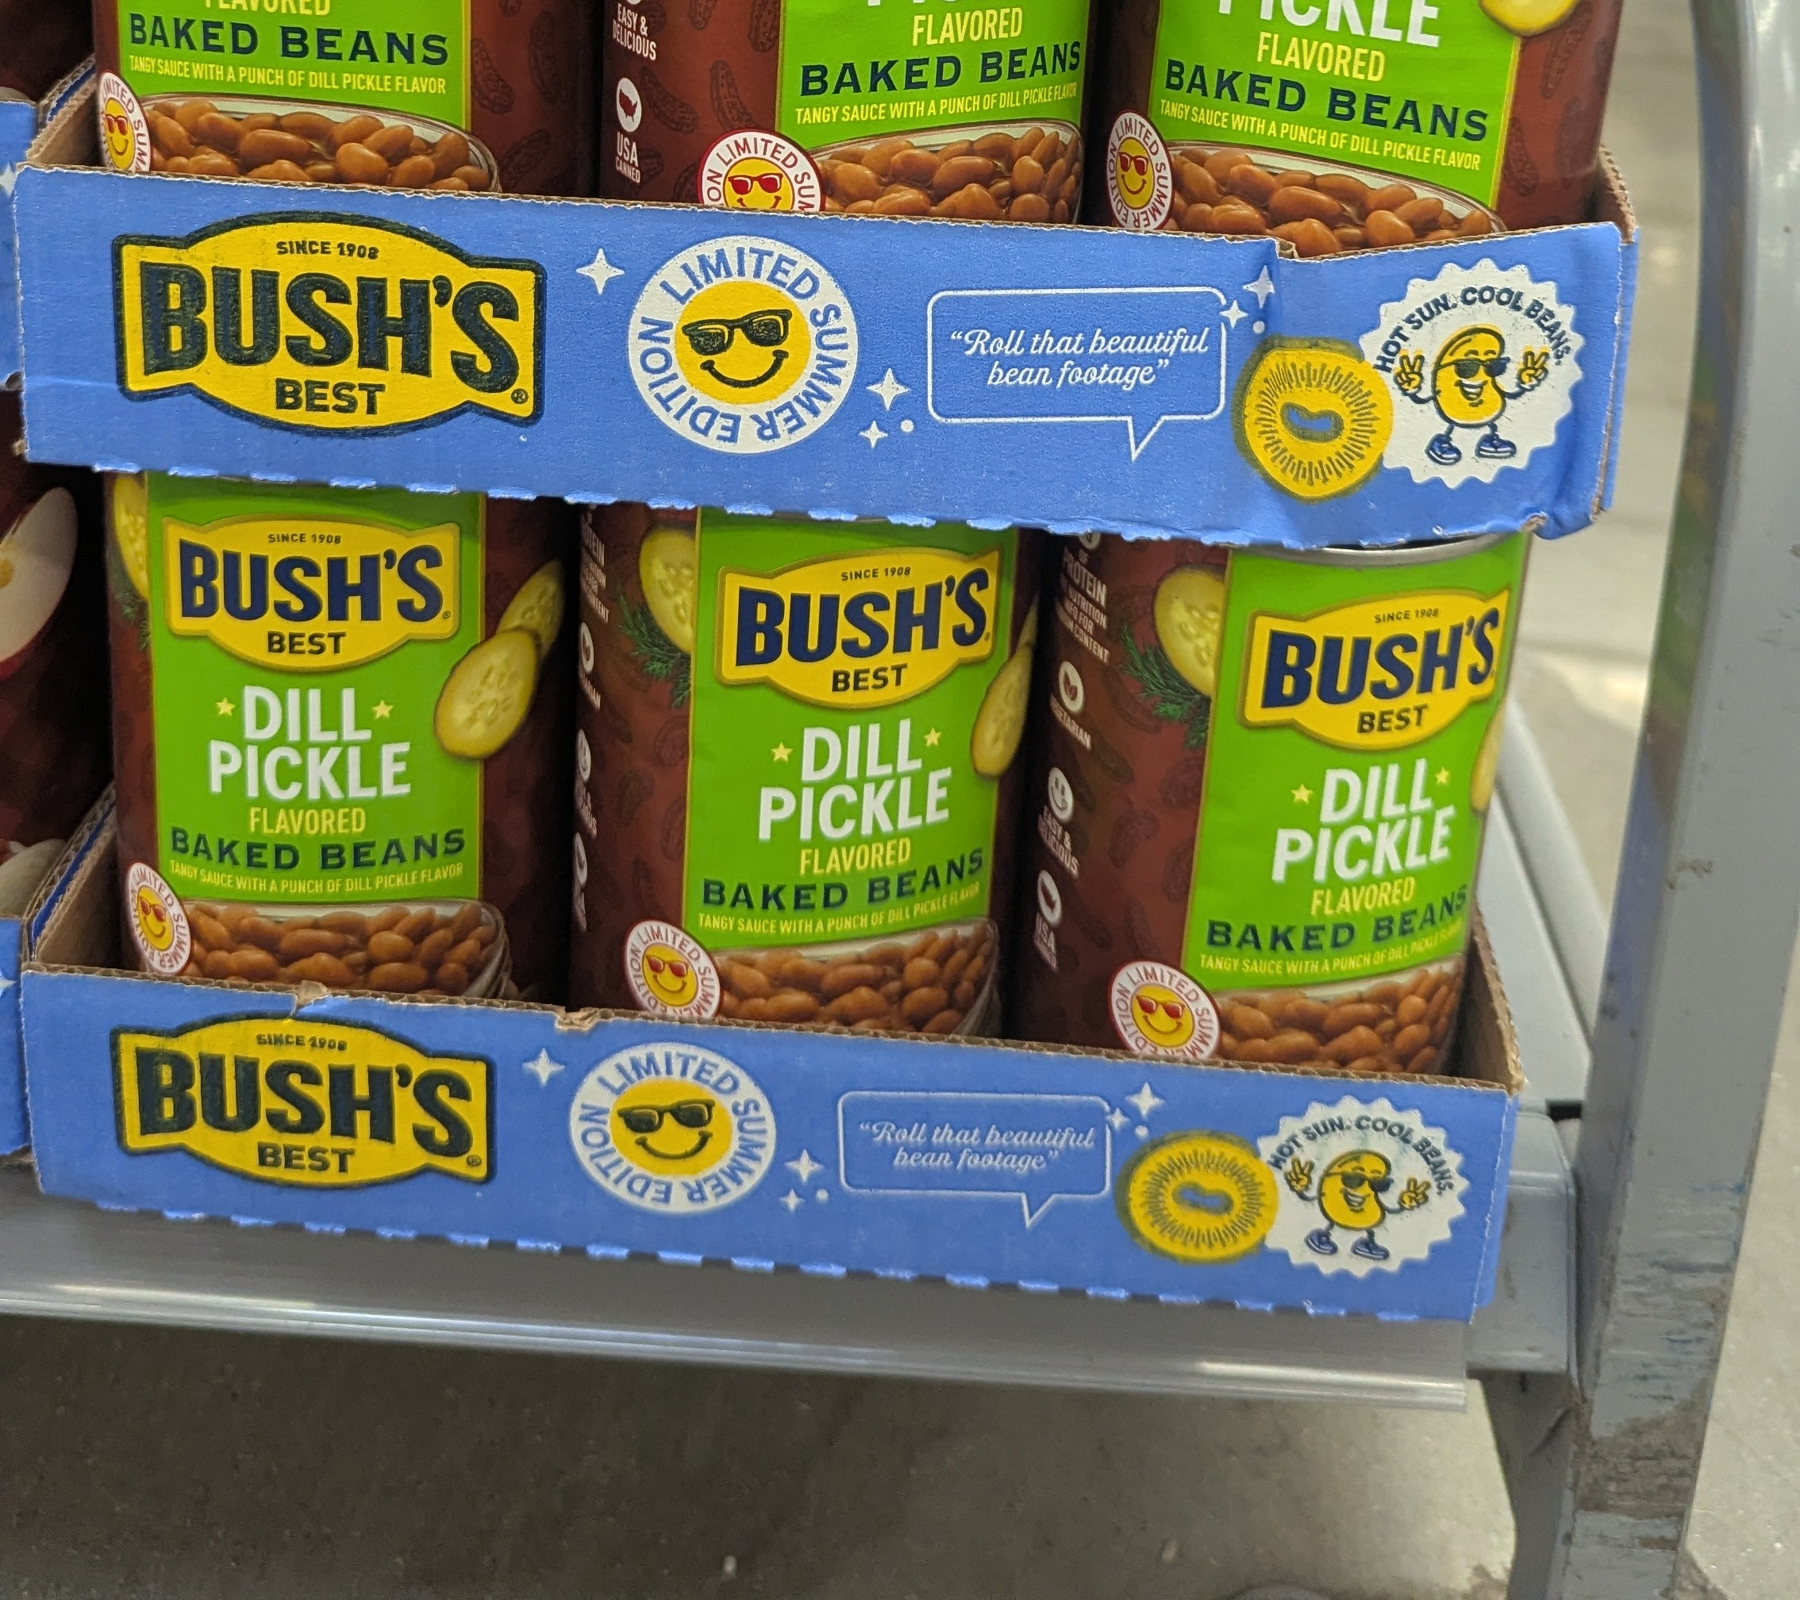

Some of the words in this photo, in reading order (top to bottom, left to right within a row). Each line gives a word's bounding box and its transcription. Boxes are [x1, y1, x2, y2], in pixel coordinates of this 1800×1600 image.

[130, 12, 258, 55] BAKED
[280, 25, 448, 66] BEANS
[612, 18, 656, 61] DELICIOUS
[617, 2, 637, 33] EASY
[639, 16, 648, 36] &
[912, 7, 1022, 46] FLAVORED
[800, 55, 962, 96] BAKED
[979, 40, 1082, 83] BEANS
[1257, 32, 1385, 82] FLAVORED
[1165, 59, 1306, 112] BAKED
[1326, 87, 1488, 142] BEANS
[616, 131, 639, 167] USA
[1160, 99, 1190, 121] TANGY
[1191, 106, 1228, 128] SAUCE
[1231, 113, 1265, 134] WITH
[1267, 121, 1278, 137] A
[1280, 122, 1326, 148] PUNCH
[1330, 132, 1348, 149] OF
[1350, 134, 1379, 155] DILL
[1383, 141, 1431, 163] PICKLE
[1433, 149, 1481, 171] FLAVOR
[276, 240, 331, 256] SINCE
[337, 242, 379, 260] 1908
[660, 246, 820, 304] LIMITED
[139, 261, 521, 393] BUSH'S
[951, 329, 1024, 356] “Roll
[1030, 333, 1084, 354] that
[1089, 328, 1209, 356] beautiful
[1372, 325, 1411, 373] HOT
[1404, 295, 1458, 330] SUN.
[1460, 286, 1524, 311] COOL
[1523, 300, 1573, 367] BEANS.
[275, 378, 385, 415] BEST
[638, 316, 742, 444] EDITION
[751, 303, 849, 442] SUMMER
[987, 361, 1052, 386] bean
[1056, 359, 1169, 391] footage”
[268, 531, 306, 544] SINCE
[311, 533, 341, 545] 1908
[178, 538, 444, 623] BUSH'S
[841, 568, 880, 583] SINCE
[884, 565, 911, 577] 1908
[735, 568, 990, 668] BUSH'S
[1375, 610, 1411, 624] SINCE
[1414, 607, 1439, 620] 1908
[268, 632, 346, 655] BEST
[1262, 607, 1499, 709] BUSH'S
[831, 663, 907, 693] BEST
[243, 685, 371, 742] DILL
[1357, 704, 1428, 735] BEST
[208, 740, 411, 800] PICKLE
[800, 718, 922, 783] DILL
[758, 767, 952, 842] PICKLE
[1319, 758, 1431, 825] DILL
[250, 806, 366, 836] FLAVORED
[1271, 805, 1456, 884] PICKLE
[171, 827, 299, 869] BAKED
[320, 828, 465, 870] BEANS
[800, 837, 911, 876] FLAVORED
[703, 877, 848, 911] BAKED
[867, 847, 983, 902] BEANS
[1311, 877, 1415, 917] FLAVORED
[1206, 918, 1357, 953] BAKED
[1372, 883, 1468, 944] BEANS
[257, 1033, 306, 1047] SINCE
[309, 1036, 347, 1052] 1908
[597, 1050, 740, 1097] LIMITED
[135, 1046, 473, 1158] BUSH'S
[257, 1142, 356, 1173] BEST
[580, 1102, 673, 1204] EDITION
[681, 1097, 767, 1202] SUMMER
